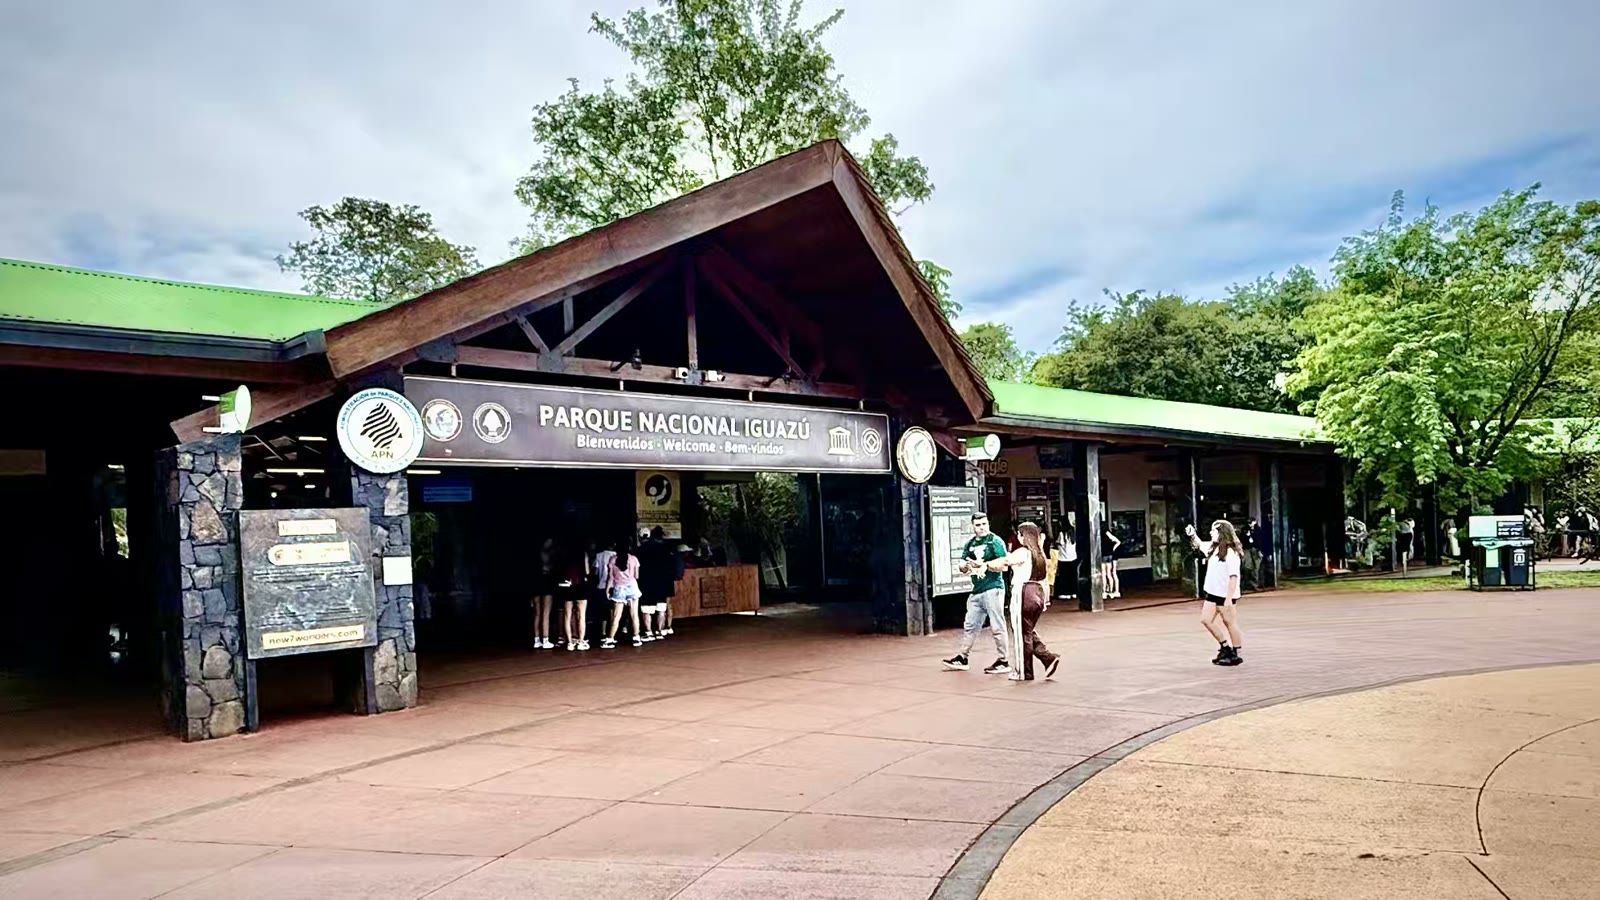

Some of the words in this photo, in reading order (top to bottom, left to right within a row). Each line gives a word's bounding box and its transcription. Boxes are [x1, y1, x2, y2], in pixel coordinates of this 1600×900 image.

[377, 391, 404, 404] PARQUES
[538, 405, 633, 433] PARQUE
[638, 413, 740, 437] NACIONAL
[744, 417, 811, 440] IGUAZÚ
[577, 434, 654, 450] Bienvenidos
[662, 438, 716, 453] Welcome
[725, 441, 784, 455] Bem-vindos
[371, 450, 394, 459] APN
